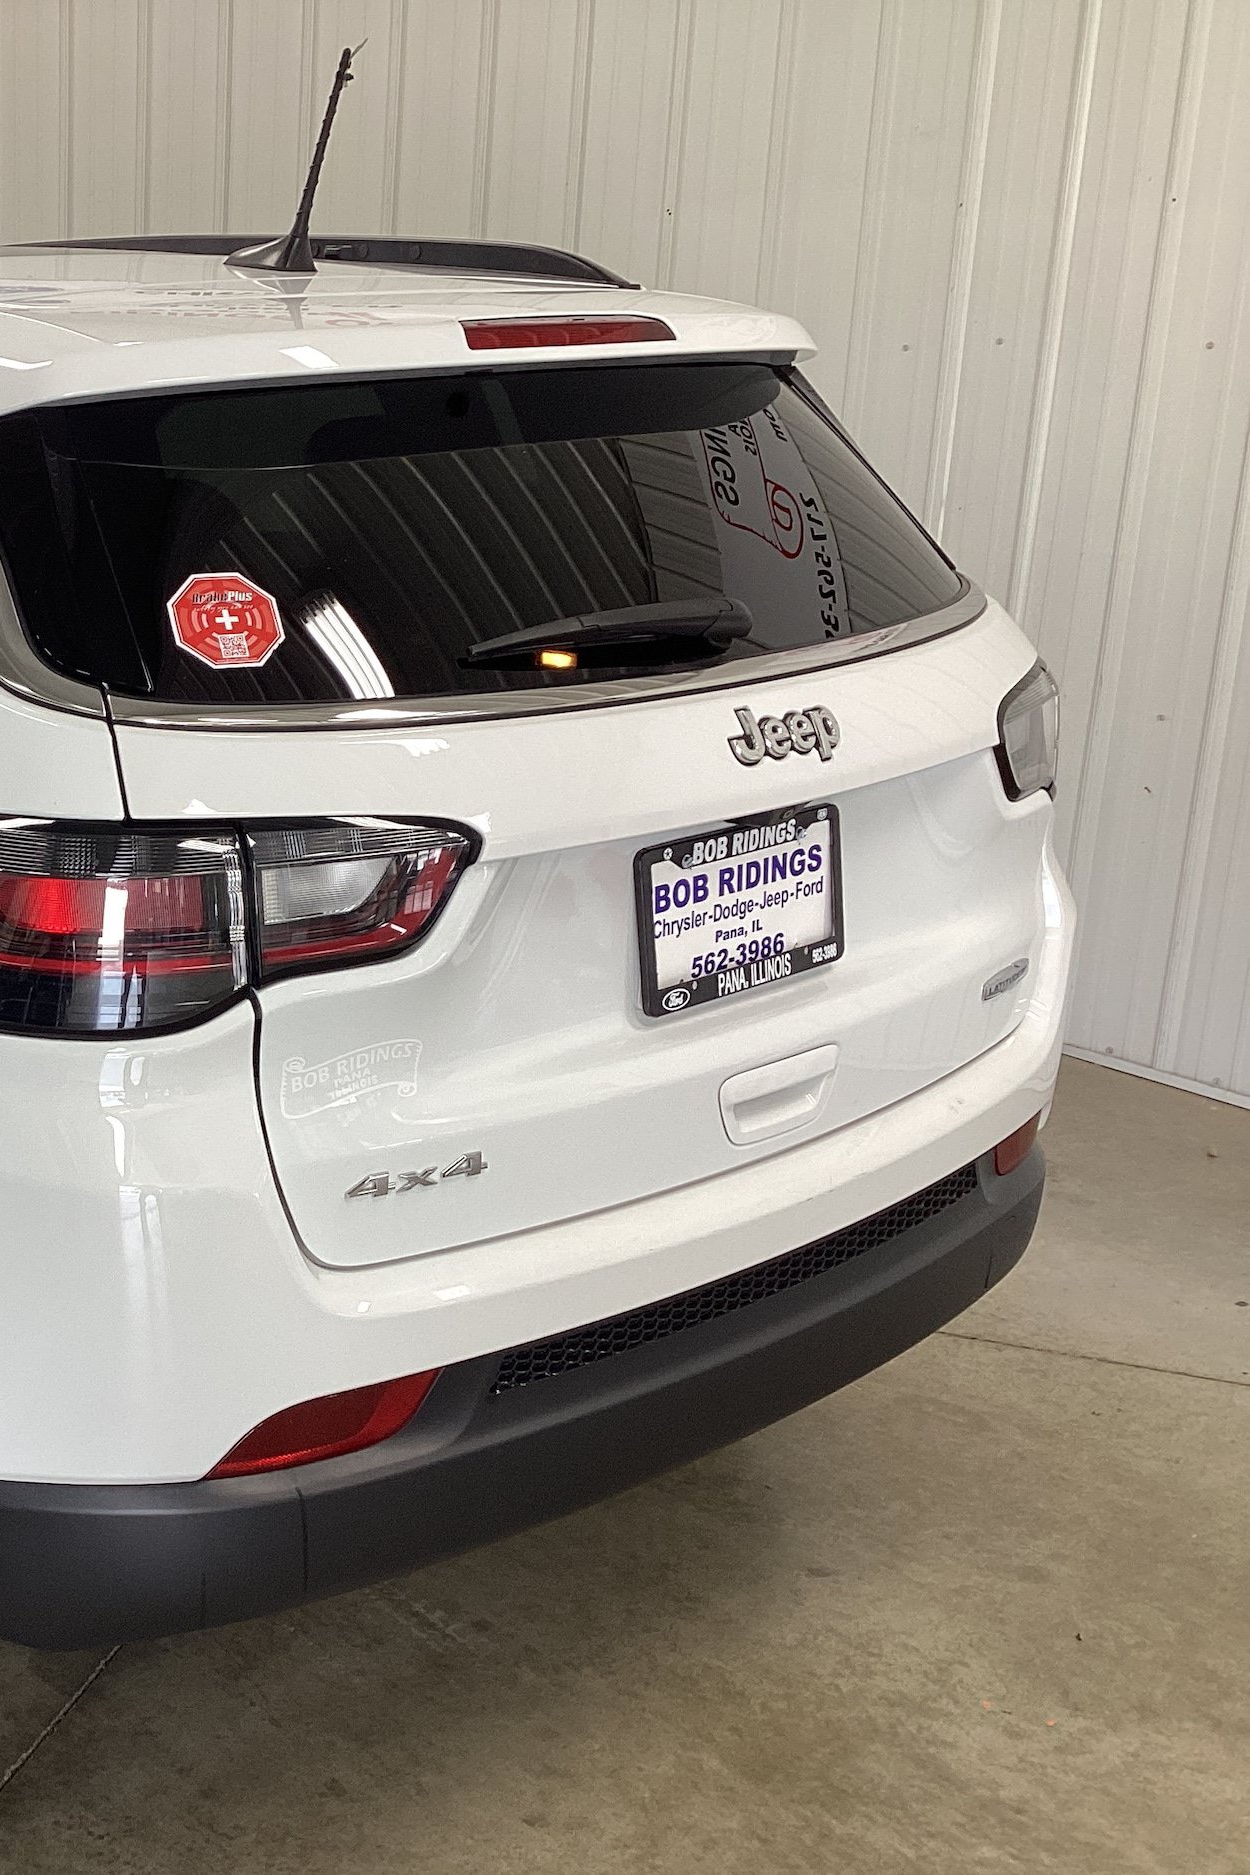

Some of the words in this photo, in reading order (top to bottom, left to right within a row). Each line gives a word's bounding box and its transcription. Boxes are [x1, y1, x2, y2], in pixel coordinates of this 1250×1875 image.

[727, 705, 841, 766] Jeep
[692, 838, 729, 864] BOB
[732, 818, 797, 855] RIDINGS
[654, 874, 709, 914] BOB
[718, 844, 823, 896] RIDINGS
[715, 926, 748, 943] Pana,
[751, 919, 763, 932] IL
[691, 932, 785, 978] 562-3986
[750, 953, 792, 986] ILLINOIS
[291, 1066, 330, 1093] BOB
[337, 1042, 414, 1074] RIDINGS
[333, 1068, 372, 1088] PANA
